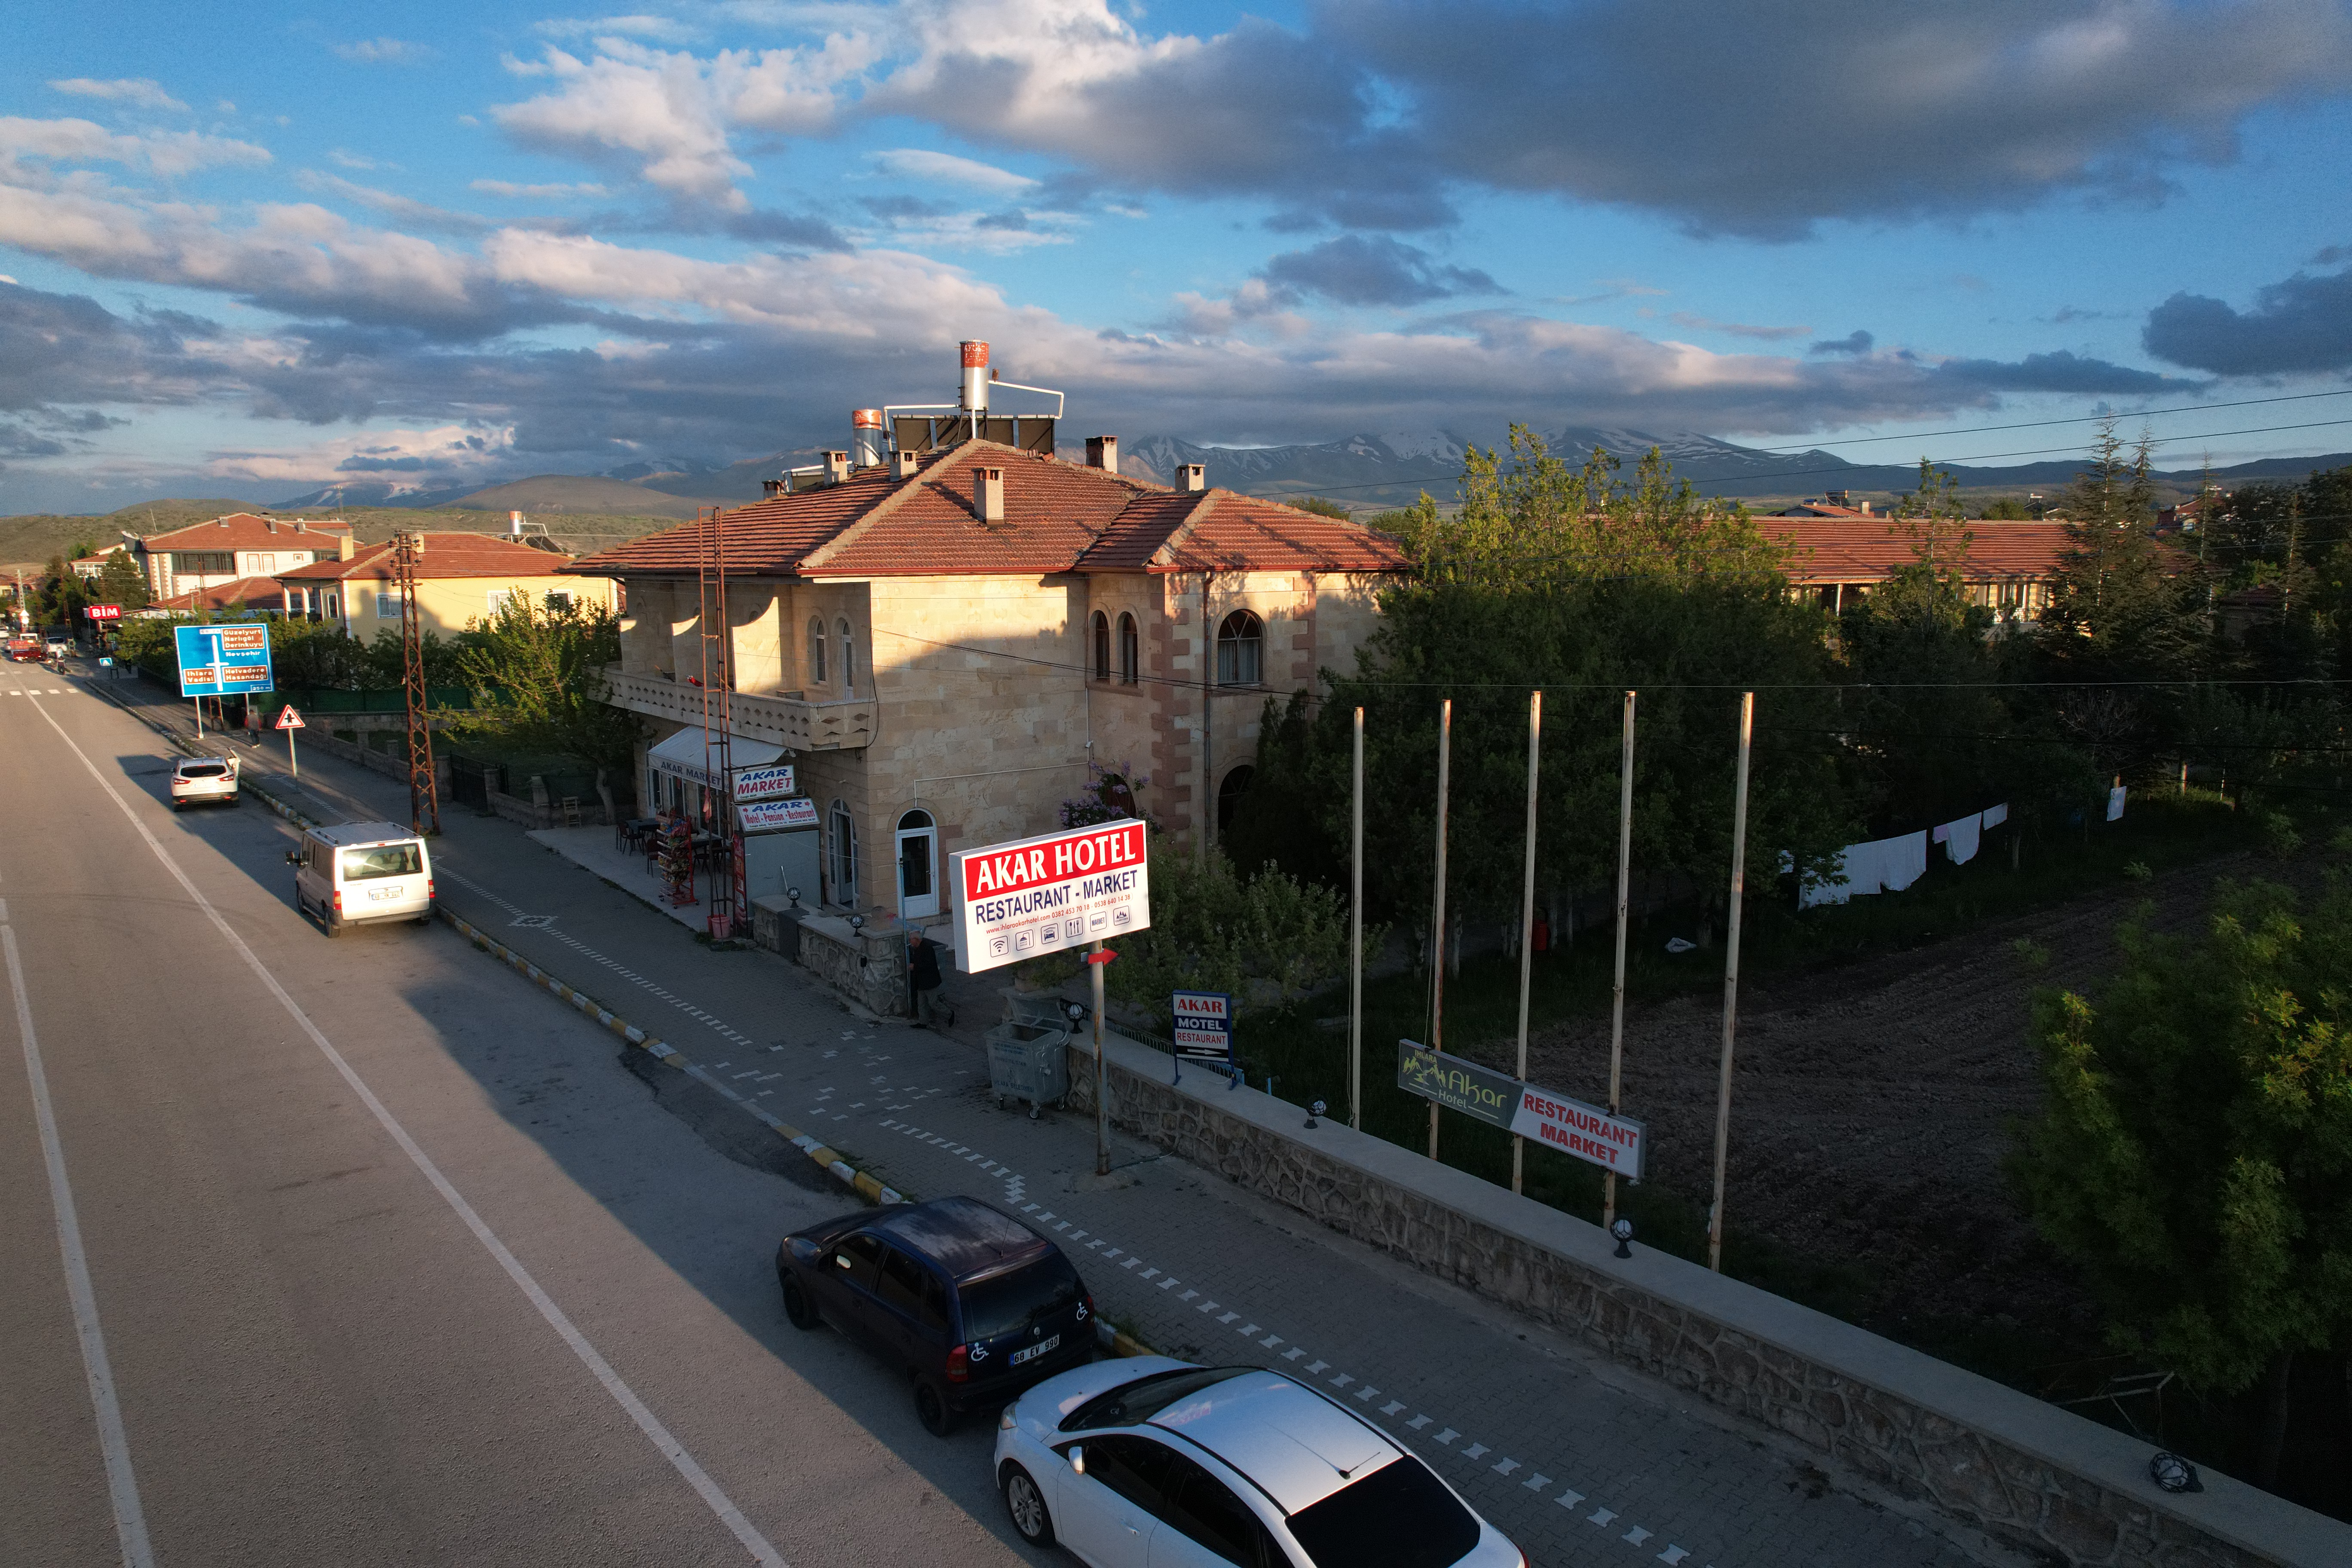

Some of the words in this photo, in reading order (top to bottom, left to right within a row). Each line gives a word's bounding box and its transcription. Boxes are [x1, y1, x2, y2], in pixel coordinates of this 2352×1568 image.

[92, 606, 118, 617] BİM
[661, 762, 683, 774] AKAR
[686, 768, 721, 786] MARKET
[741, 769, 788, 782] AKAR
[737, 777, 792, 795] MARKET
[752, 801, 802, 812] AKAR
[744, 812, 760, 824] Motel
[763, 811, 784, 822] Pansion
[787, 808, 815, 820] Restaurant
[976, 849, 1047, 893] AKAR
[1055, 831, 1136, 876] HOTEL
[976, 885, 1071, 925] RESTAURANT
[1083, 870, 1137, 900] MARKET
[986, 916, 1050, 934] www.ihlaraakarhotel.com
[1052, 910, 1064, 918] 0382
[1095, 900, 1106, 908] 0538
[1092, 917, 1105, 926] MARKET
[1178, 998, 1222, 1013] AKAR
[1178, 1017, 1223, 1030] MOTEL
[1177, 1032, 1226, 1044] RESTAURANT
[1415, 1049, 1437, 1063] IHLARA
[1449, 1071, 1507, 1108] Akar
[1438, 1089, 1467, 1109] Hotel
[1524, 1093, 1637, 1148] RESTAURANT
[1540, 1122, 1618, 1164] MARKET
[1014, 1352, 1025, 1363] 68
[1030, 1345, 1040, 1357] EV
[1045, 1336, 1058, 1350] 990
